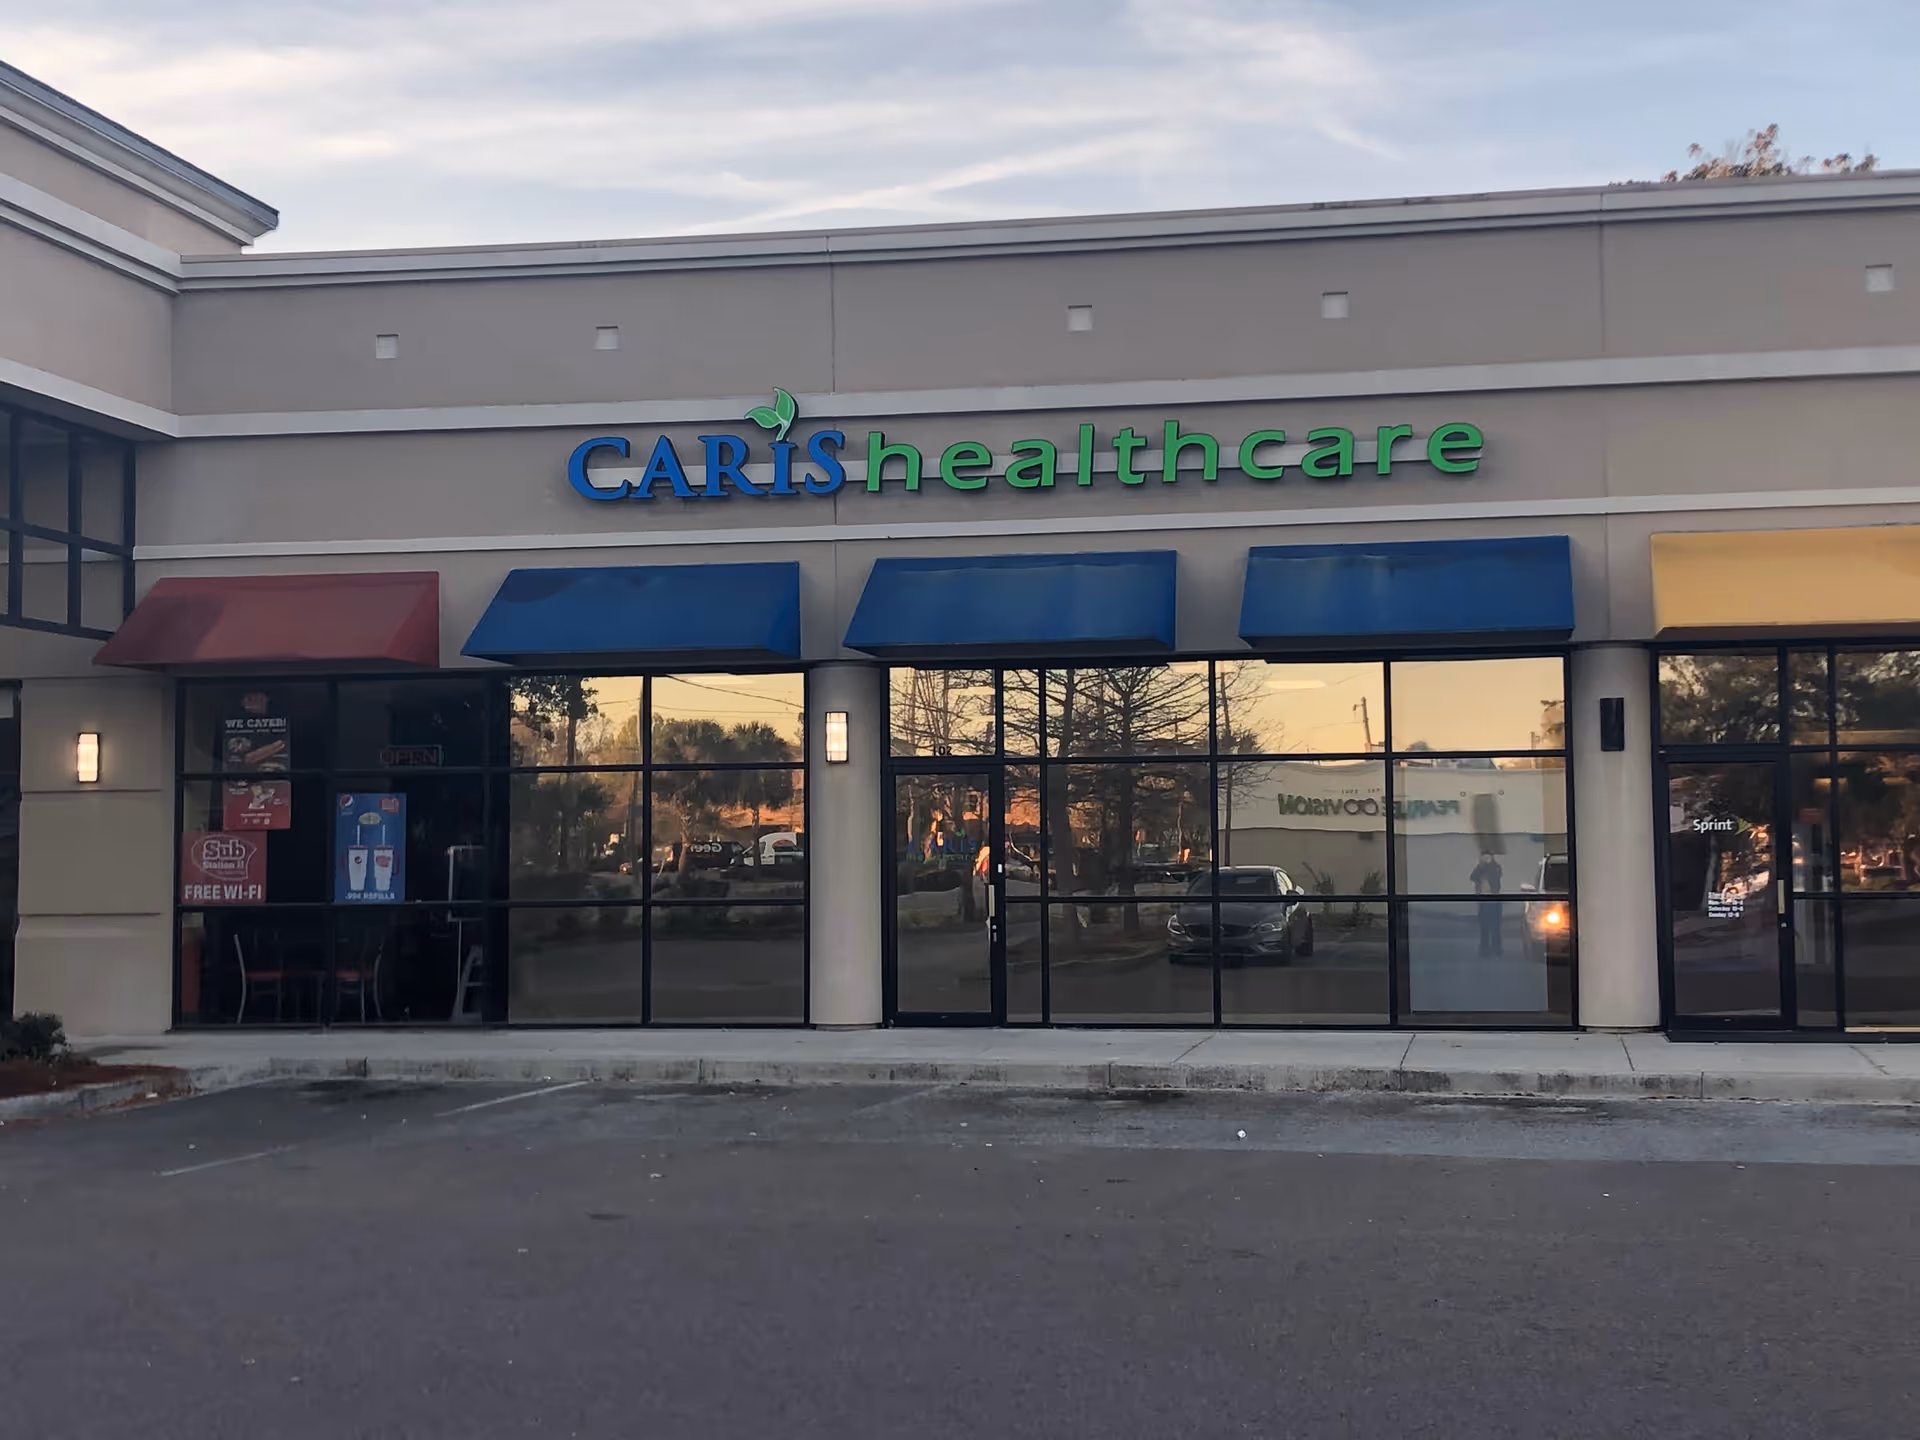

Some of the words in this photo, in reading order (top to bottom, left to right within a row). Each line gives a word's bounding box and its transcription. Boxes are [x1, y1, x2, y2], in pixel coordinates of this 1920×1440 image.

[866, 420, 1485, 492] healthcare
[226, 719, 244, 728] WE
[247, 717, 287, 729] CATER!
[381, 750, 438, 765] OPEN
[1693, 819, 1734, 833] Sprint
[203, 839, 246, 859] Sub
[203, 860, 235, 869] Station
[185, 884, 221, 900] FREE
[223, 884, 262, 900] WI-FI
